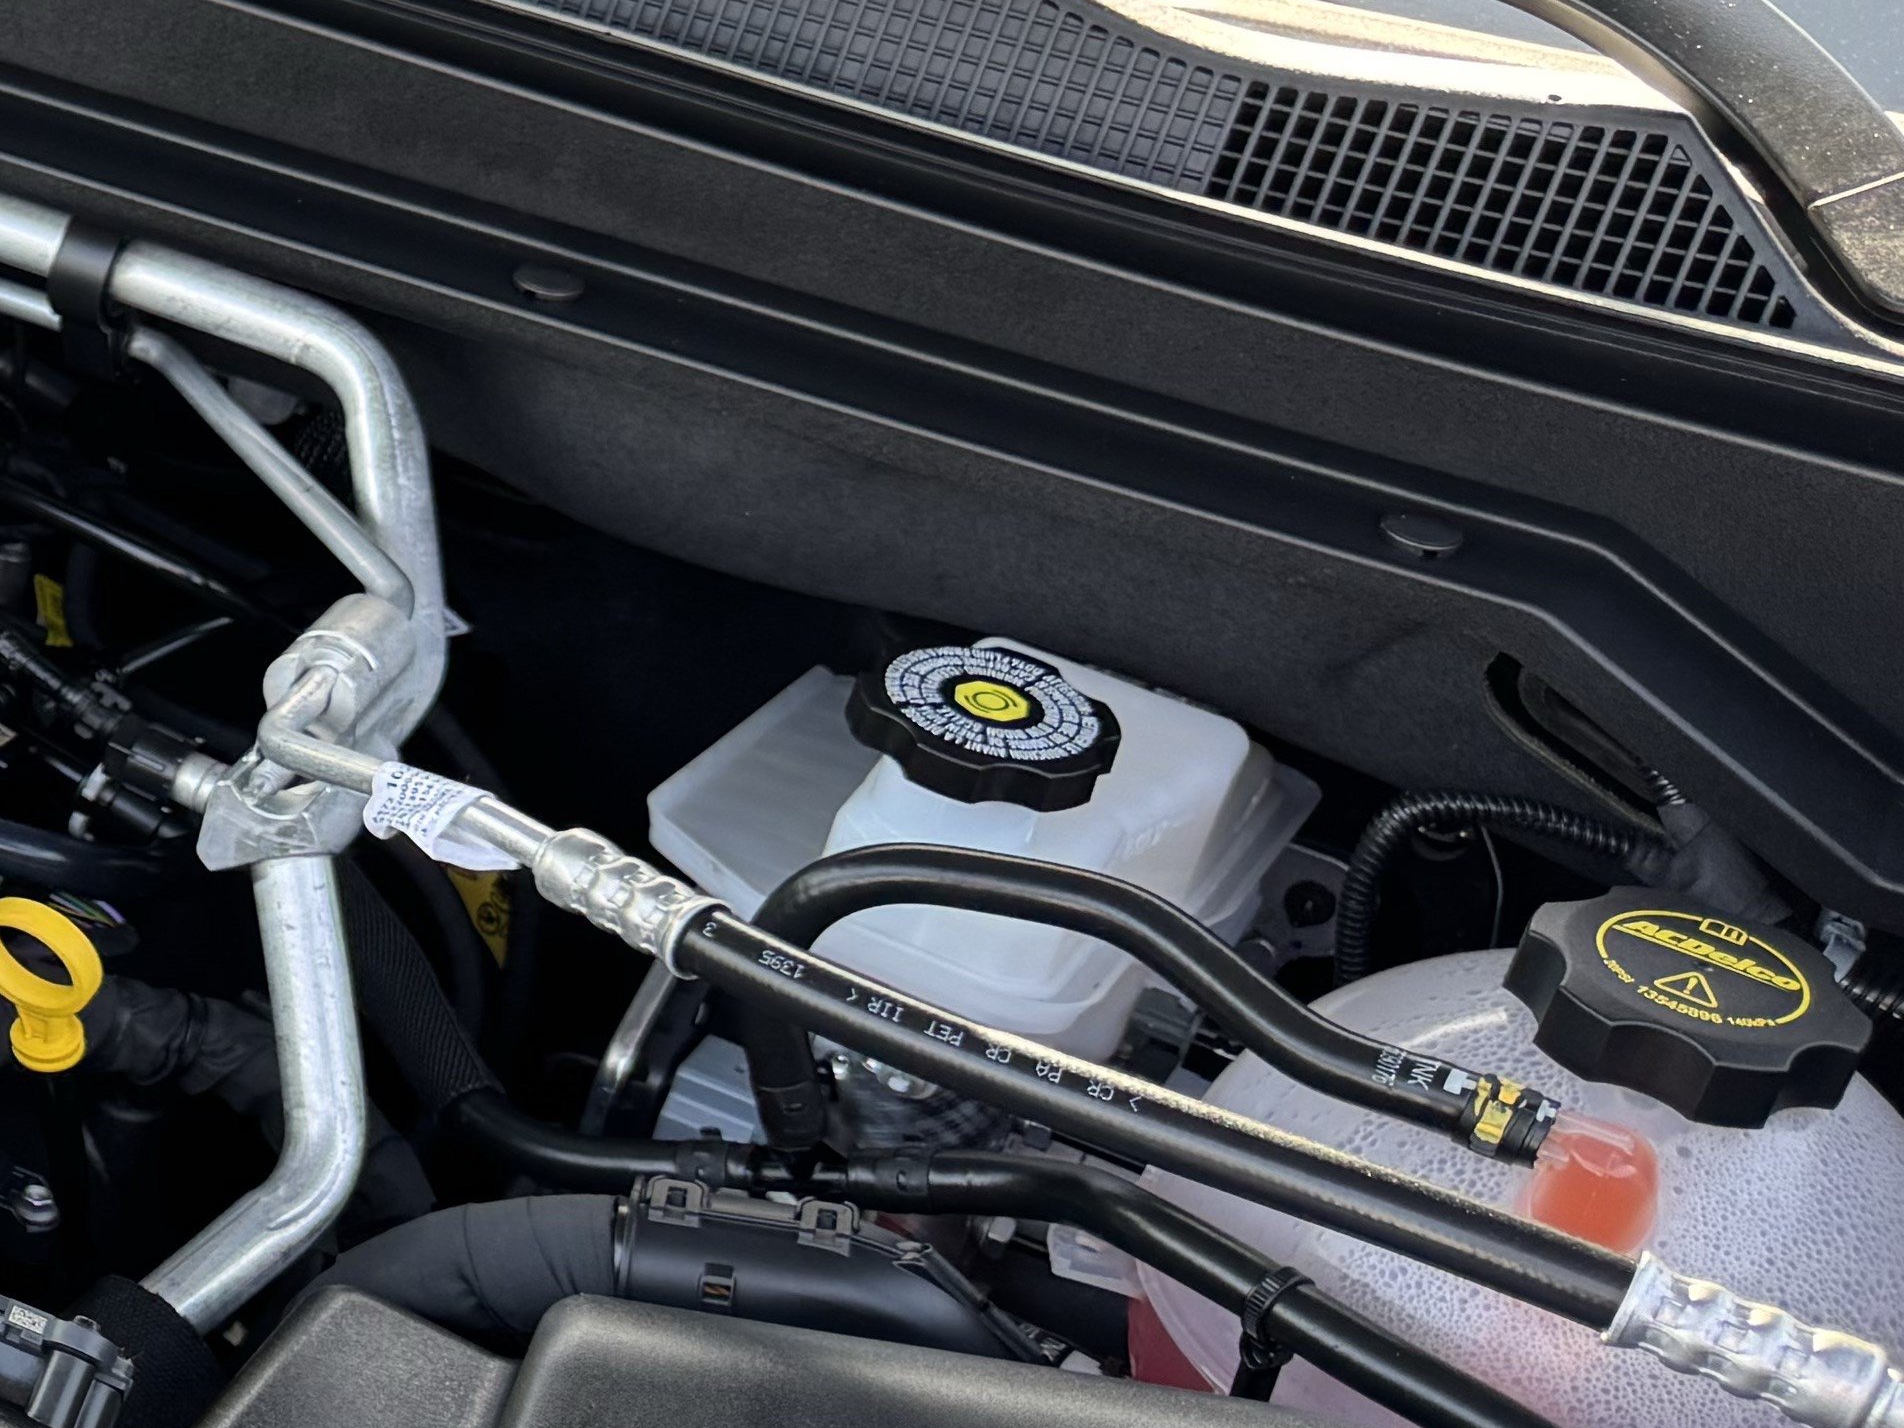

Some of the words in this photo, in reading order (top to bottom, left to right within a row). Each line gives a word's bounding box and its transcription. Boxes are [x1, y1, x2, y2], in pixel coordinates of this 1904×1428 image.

[758, 949, 808, 979] 1395
[1622, 919, 1802, 991] ACDelco
[923, 1019, 965, 1048] PET
[985, 1043, 1012, 1064] CR
[1036, 1059, 1063, 1084] PA
[1087, 1079, 1114, 1102] CR
